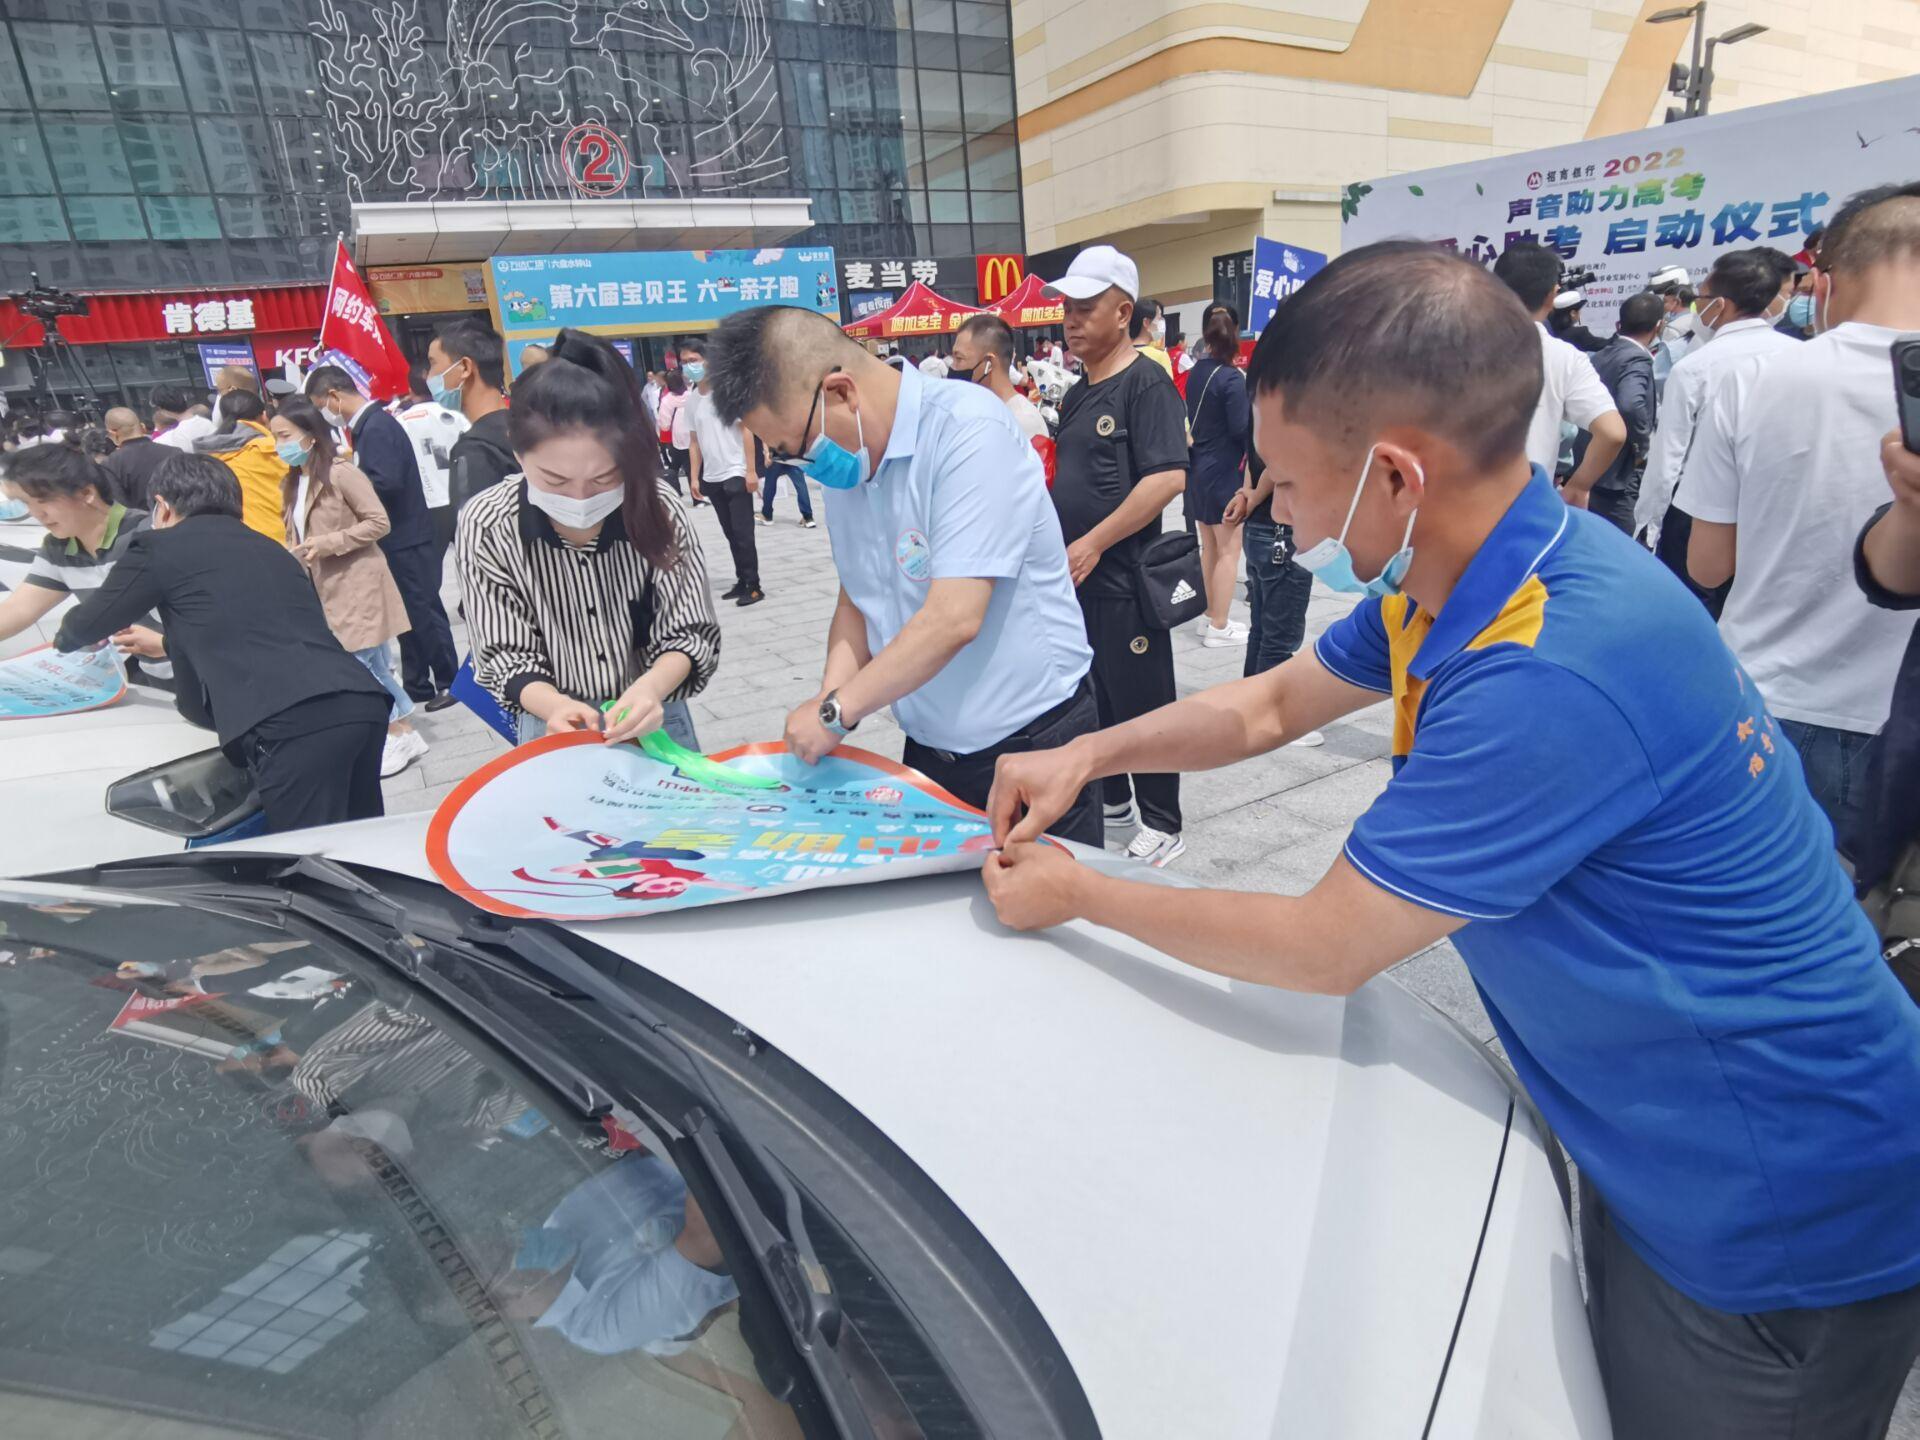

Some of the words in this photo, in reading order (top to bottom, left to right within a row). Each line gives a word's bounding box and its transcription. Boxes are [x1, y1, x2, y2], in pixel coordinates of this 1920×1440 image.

[579, 134, 616, 183] 2
[1546, 164, 1596, 184] 招商银行
[1603, 147, 1687, 178] 2022
[1507, 171, 1706, 224] 声音助力高考
[1603, 191, 1833, 256] 启动仪式
[548, 280, 688, 310] 第六届宝贝王
[697, 275, 800, 304] 六一亲子跑
[844, 260, 939, 290] 麦当劳
[162, 298, 256, 334] 肯德基
[890, 312, 943, 333] 喝加多宝
